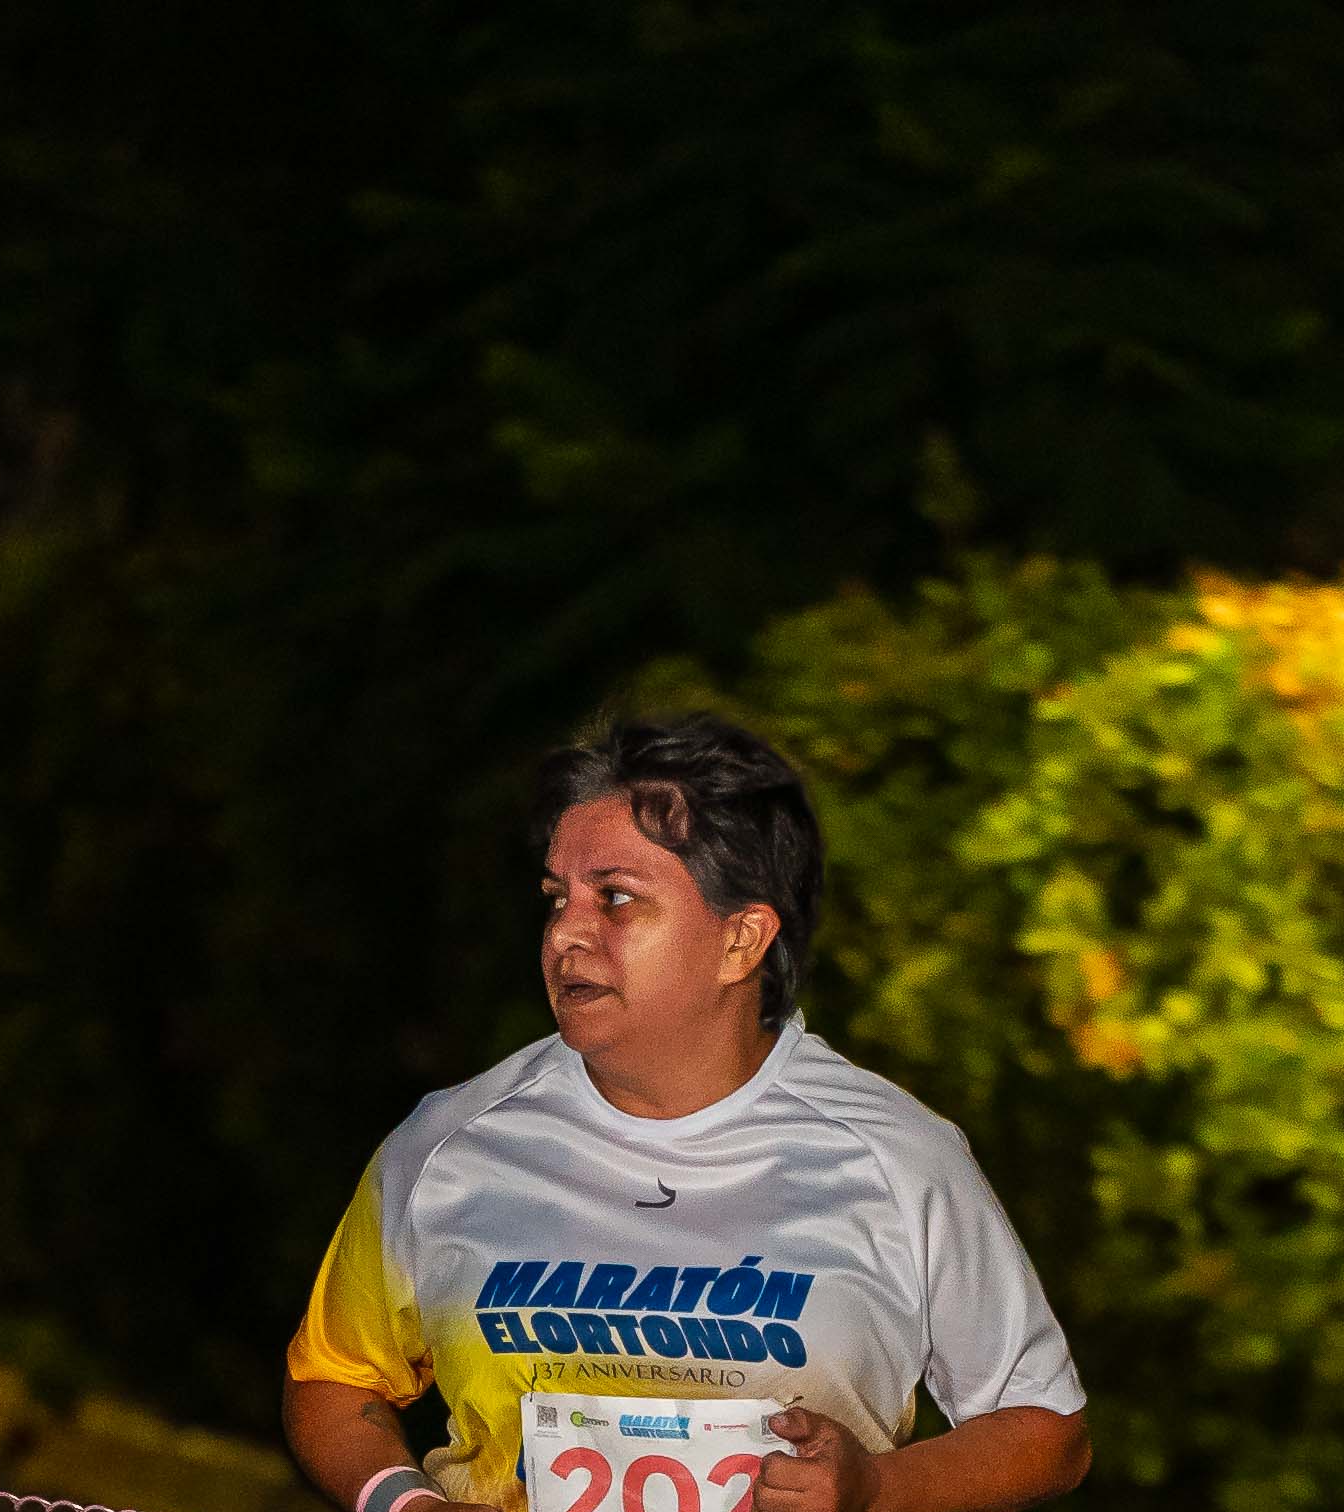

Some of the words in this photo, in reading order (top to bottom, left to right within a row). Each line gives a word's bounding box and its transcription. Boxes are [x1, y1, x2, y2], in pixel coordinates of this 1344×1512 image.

[475, 1256, 815, 1321] MARATÓN
[476, 1312, 807, 1369] ELORTONDO
[532, 1363, 565, 1380] 137
[576, 1363, 746, 1388] ANIVERSARIO
